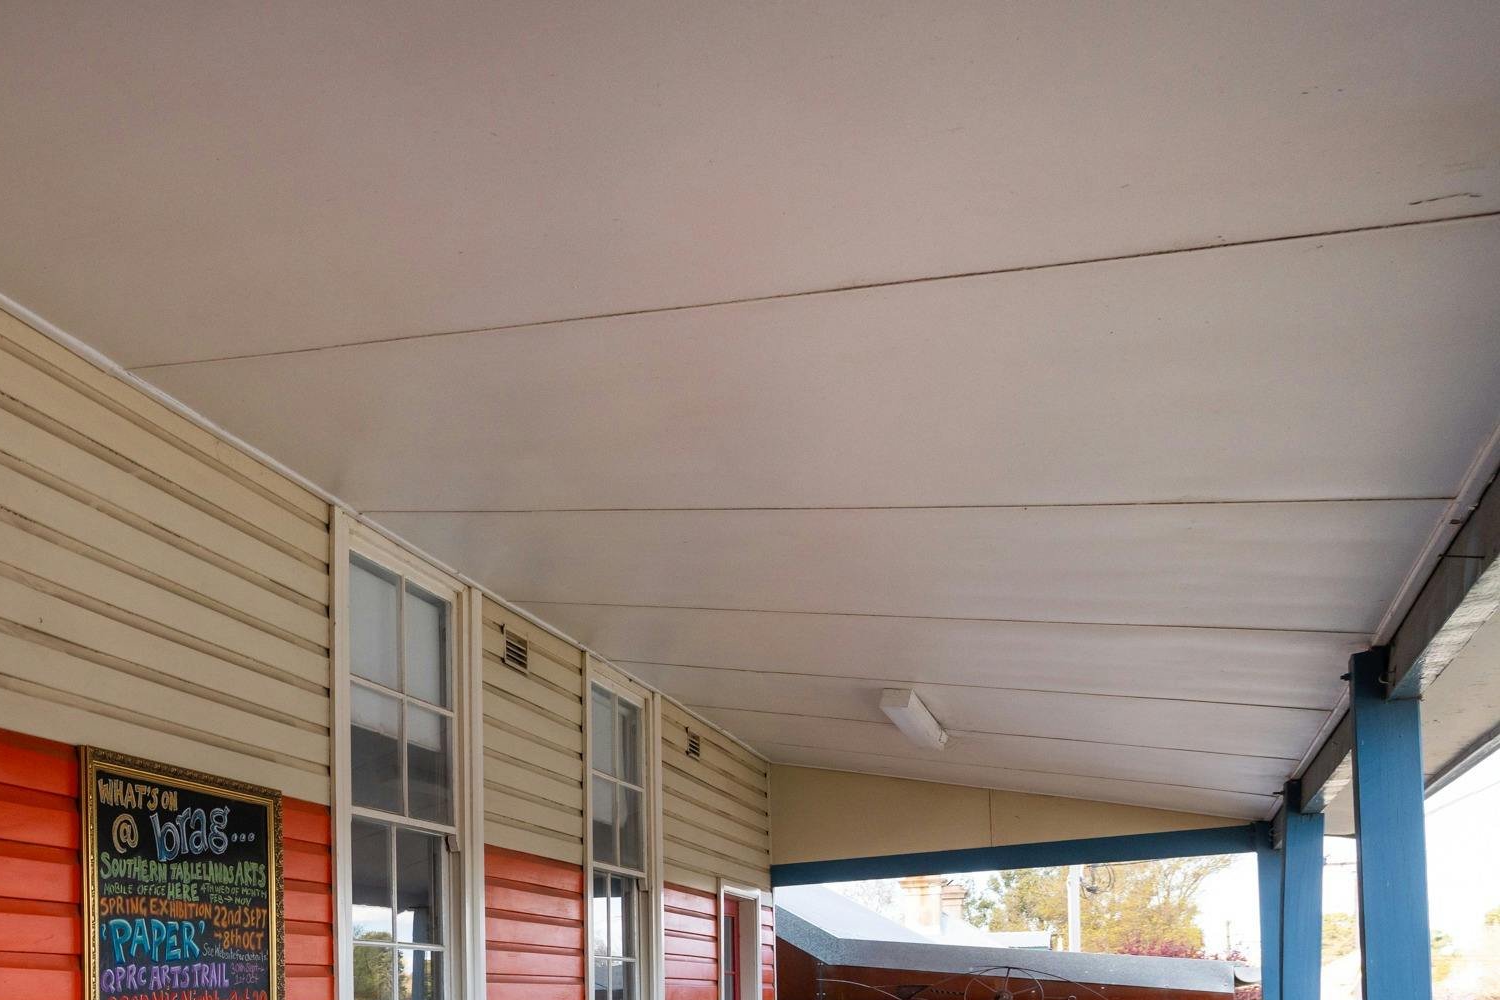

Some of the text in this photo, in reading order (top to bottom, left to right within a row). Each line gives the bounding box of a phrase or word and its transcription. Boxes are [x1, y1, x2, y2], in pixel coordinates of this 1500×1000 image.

[98, 779, 179, 811] WHAT'S ON
[112, 813, 139, 854] @
[100, 852, 168, 883] SOUTHERN
[235, 861, 267, 888] ARTS
[103, 882, 201, 903] MOBILE OFFICE HERE
[210, 894, 224, 904] FEB
[241, 887, 267, 900] MONTH
[100, 896, 268, 929] SPRING EXHIBITION 22nd SEPT
[222, 930, 264, 952] 8th OCT
[101, 962, 230, 993] QPRC ARTS TRAIL
